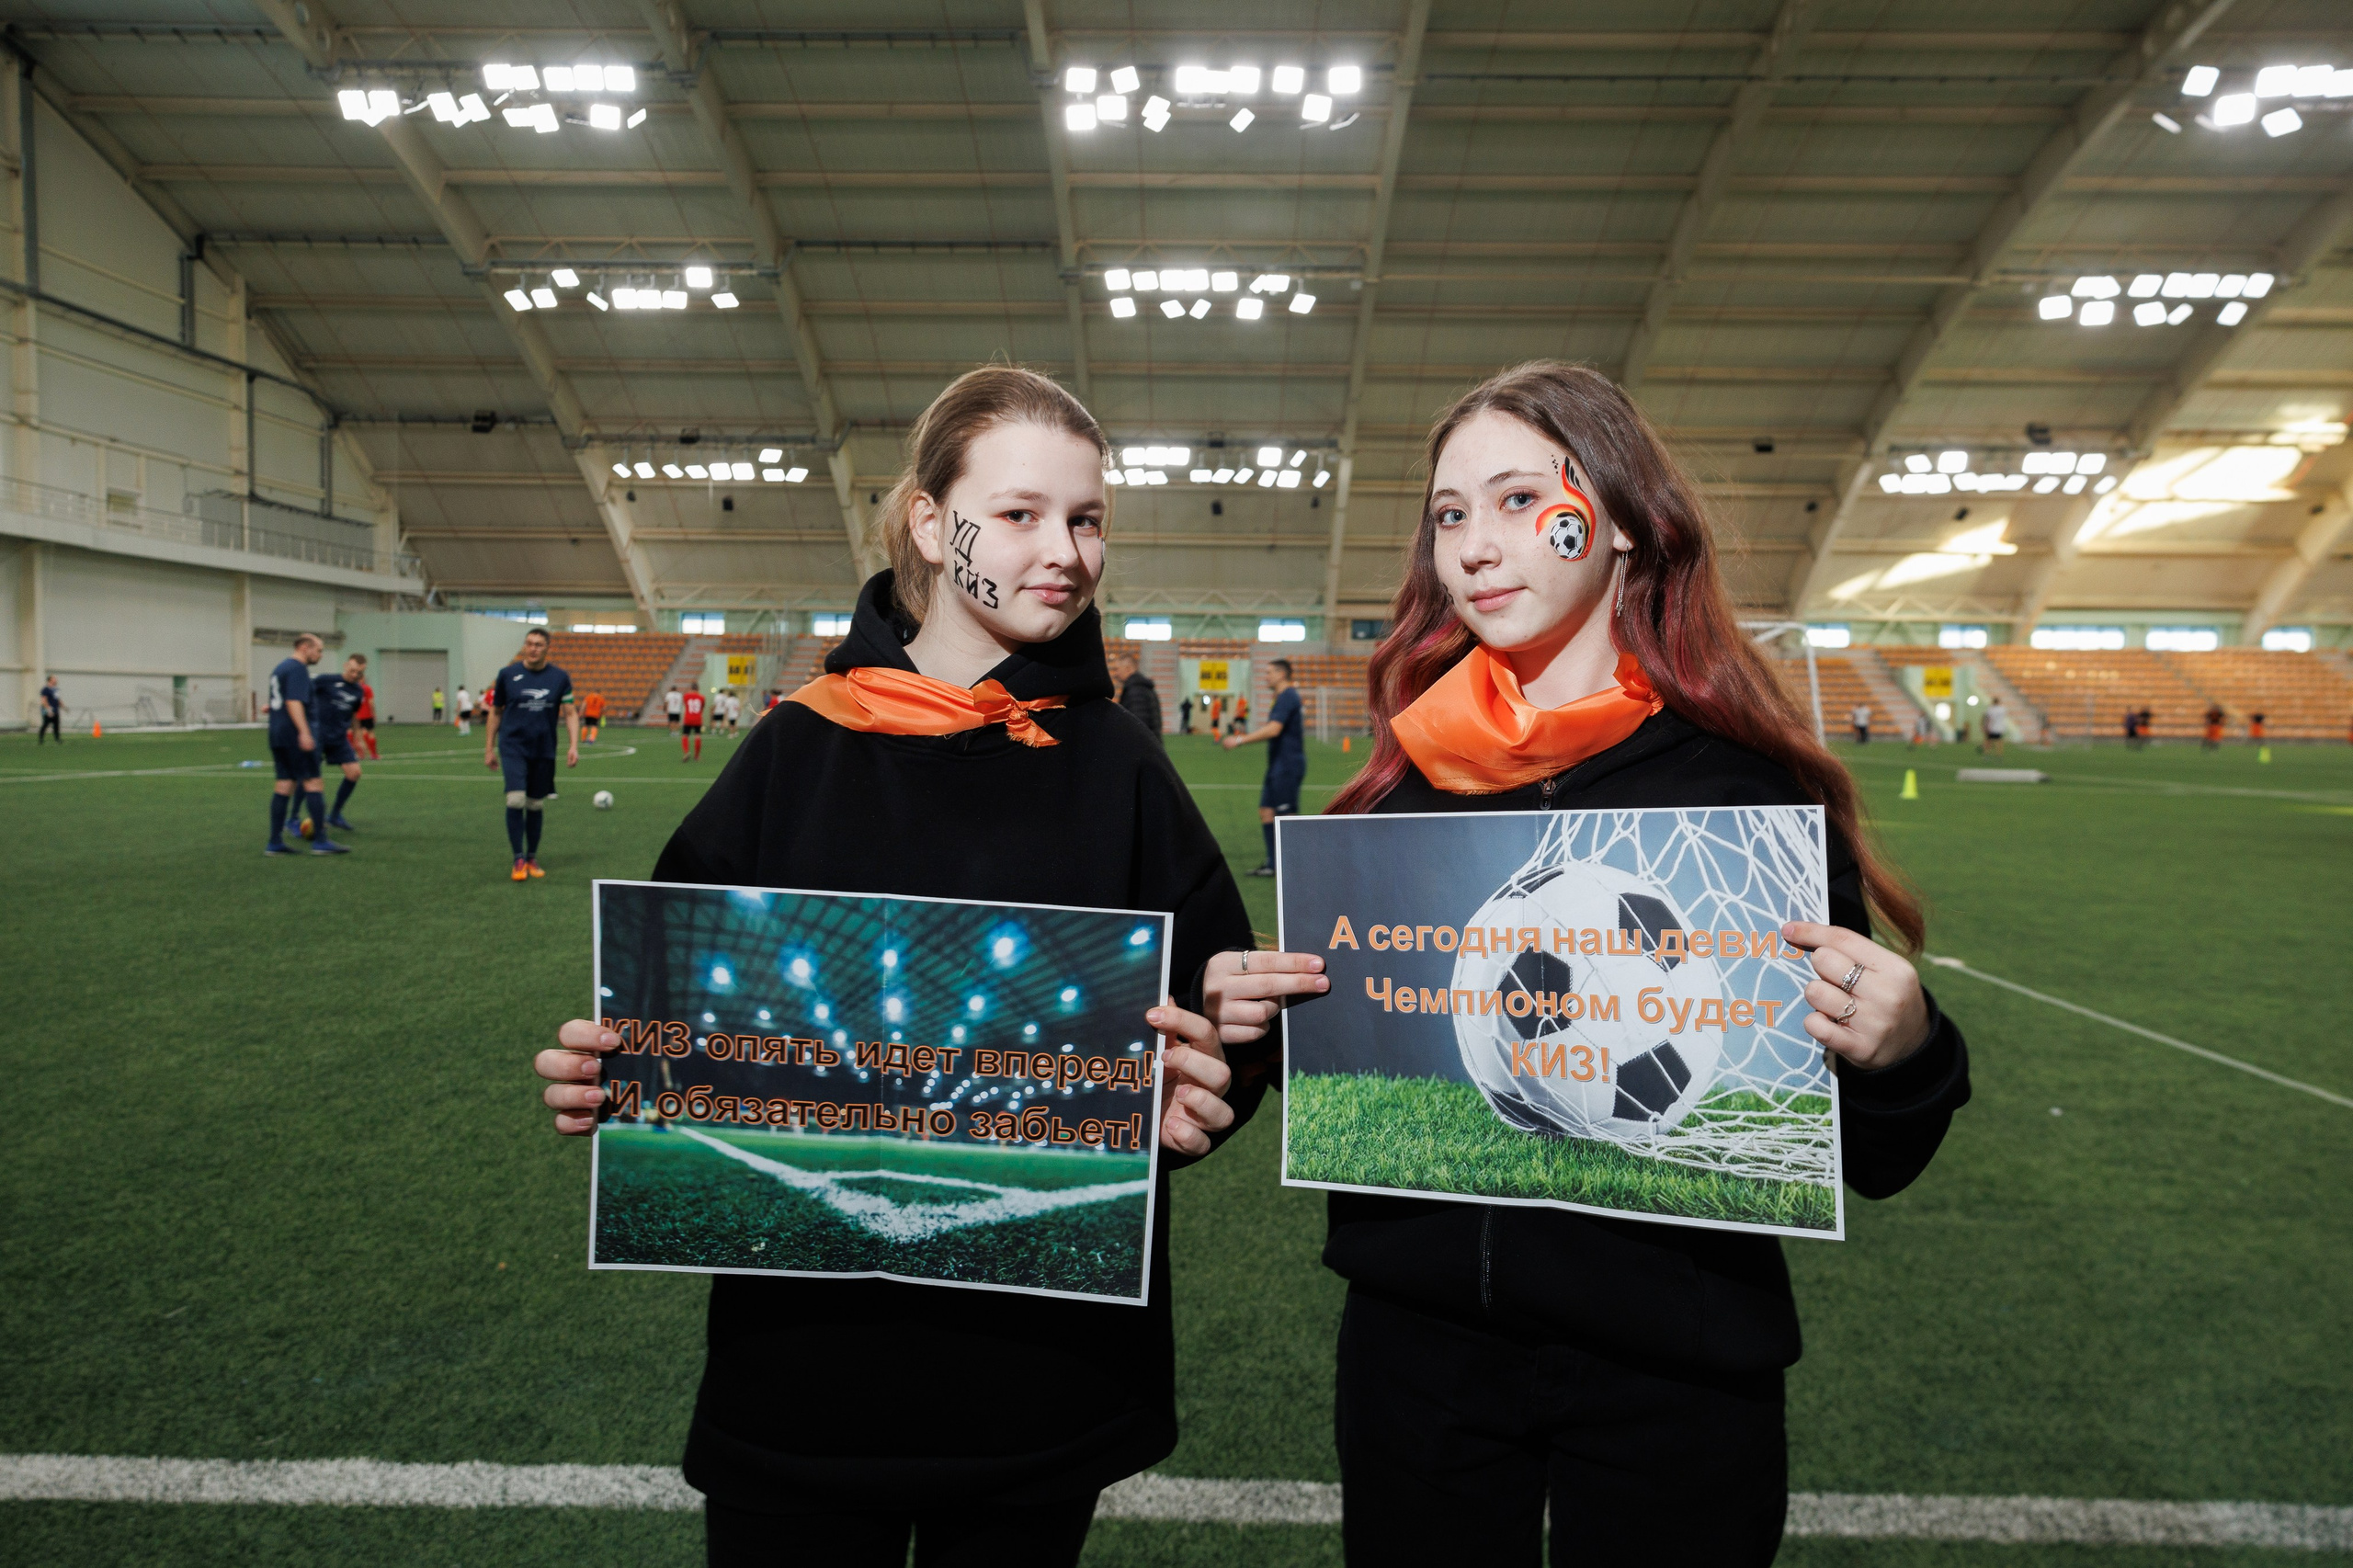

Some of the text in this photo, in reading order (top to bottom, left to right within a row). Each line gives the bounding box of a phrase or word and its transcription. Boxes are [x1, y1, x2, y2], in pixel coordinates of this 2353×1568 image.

[953, 560, 999, 609] КИЗ
[1328, 915, 1359, 950] А
[1368, 923, 1542, 959] сегодня
[1552, 926, 1643, 958] наш
[1365, 976, 1784, 1035] Чемпионом будет
[705, 1032, 841, 1068] опять
[855, 1041, 962, 1078] идет
[974, 1049, 1155, 1093] вперед!
[1510, 1040, 1611, 1084] КИЗ!
[609, 1079, 1143, 1151] И обязательно забьет!
